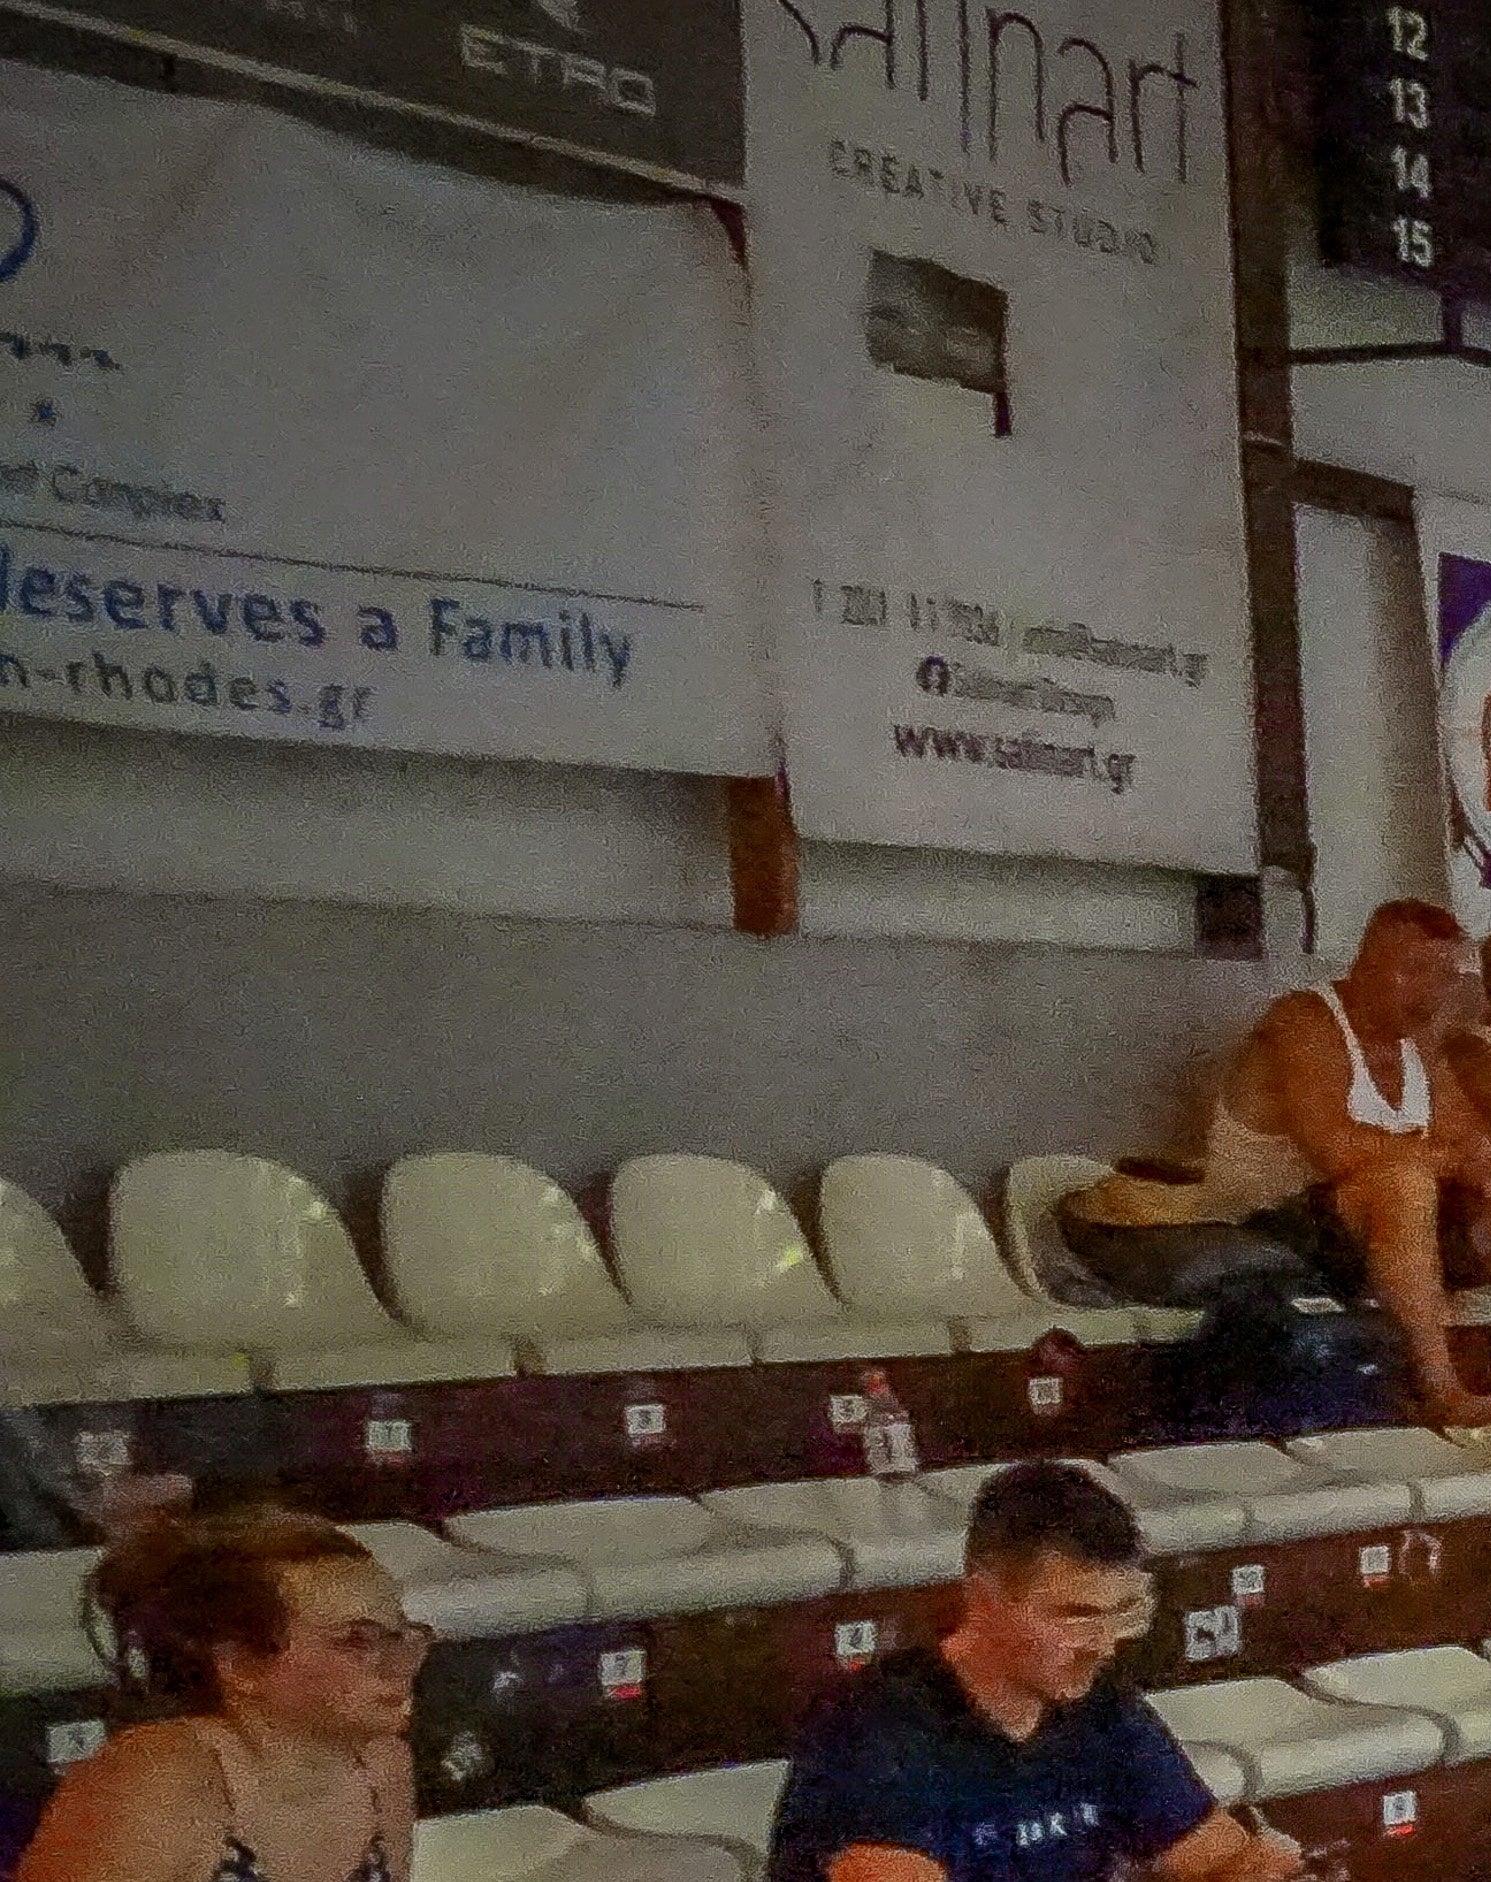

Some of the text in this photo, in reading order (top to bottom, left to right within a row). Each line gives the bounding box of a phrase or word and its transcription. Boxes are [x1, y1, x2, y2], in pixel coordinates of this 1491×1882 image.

[1386, 6, 1429, 62] 12
[1389, 75, 1431, 131] 13
[1391, 146, 1432, 200] 14
[1391, 215, 1432, 269] 15
[357, 604, 399, 651] a
[428, 596, 634, 691] Family
